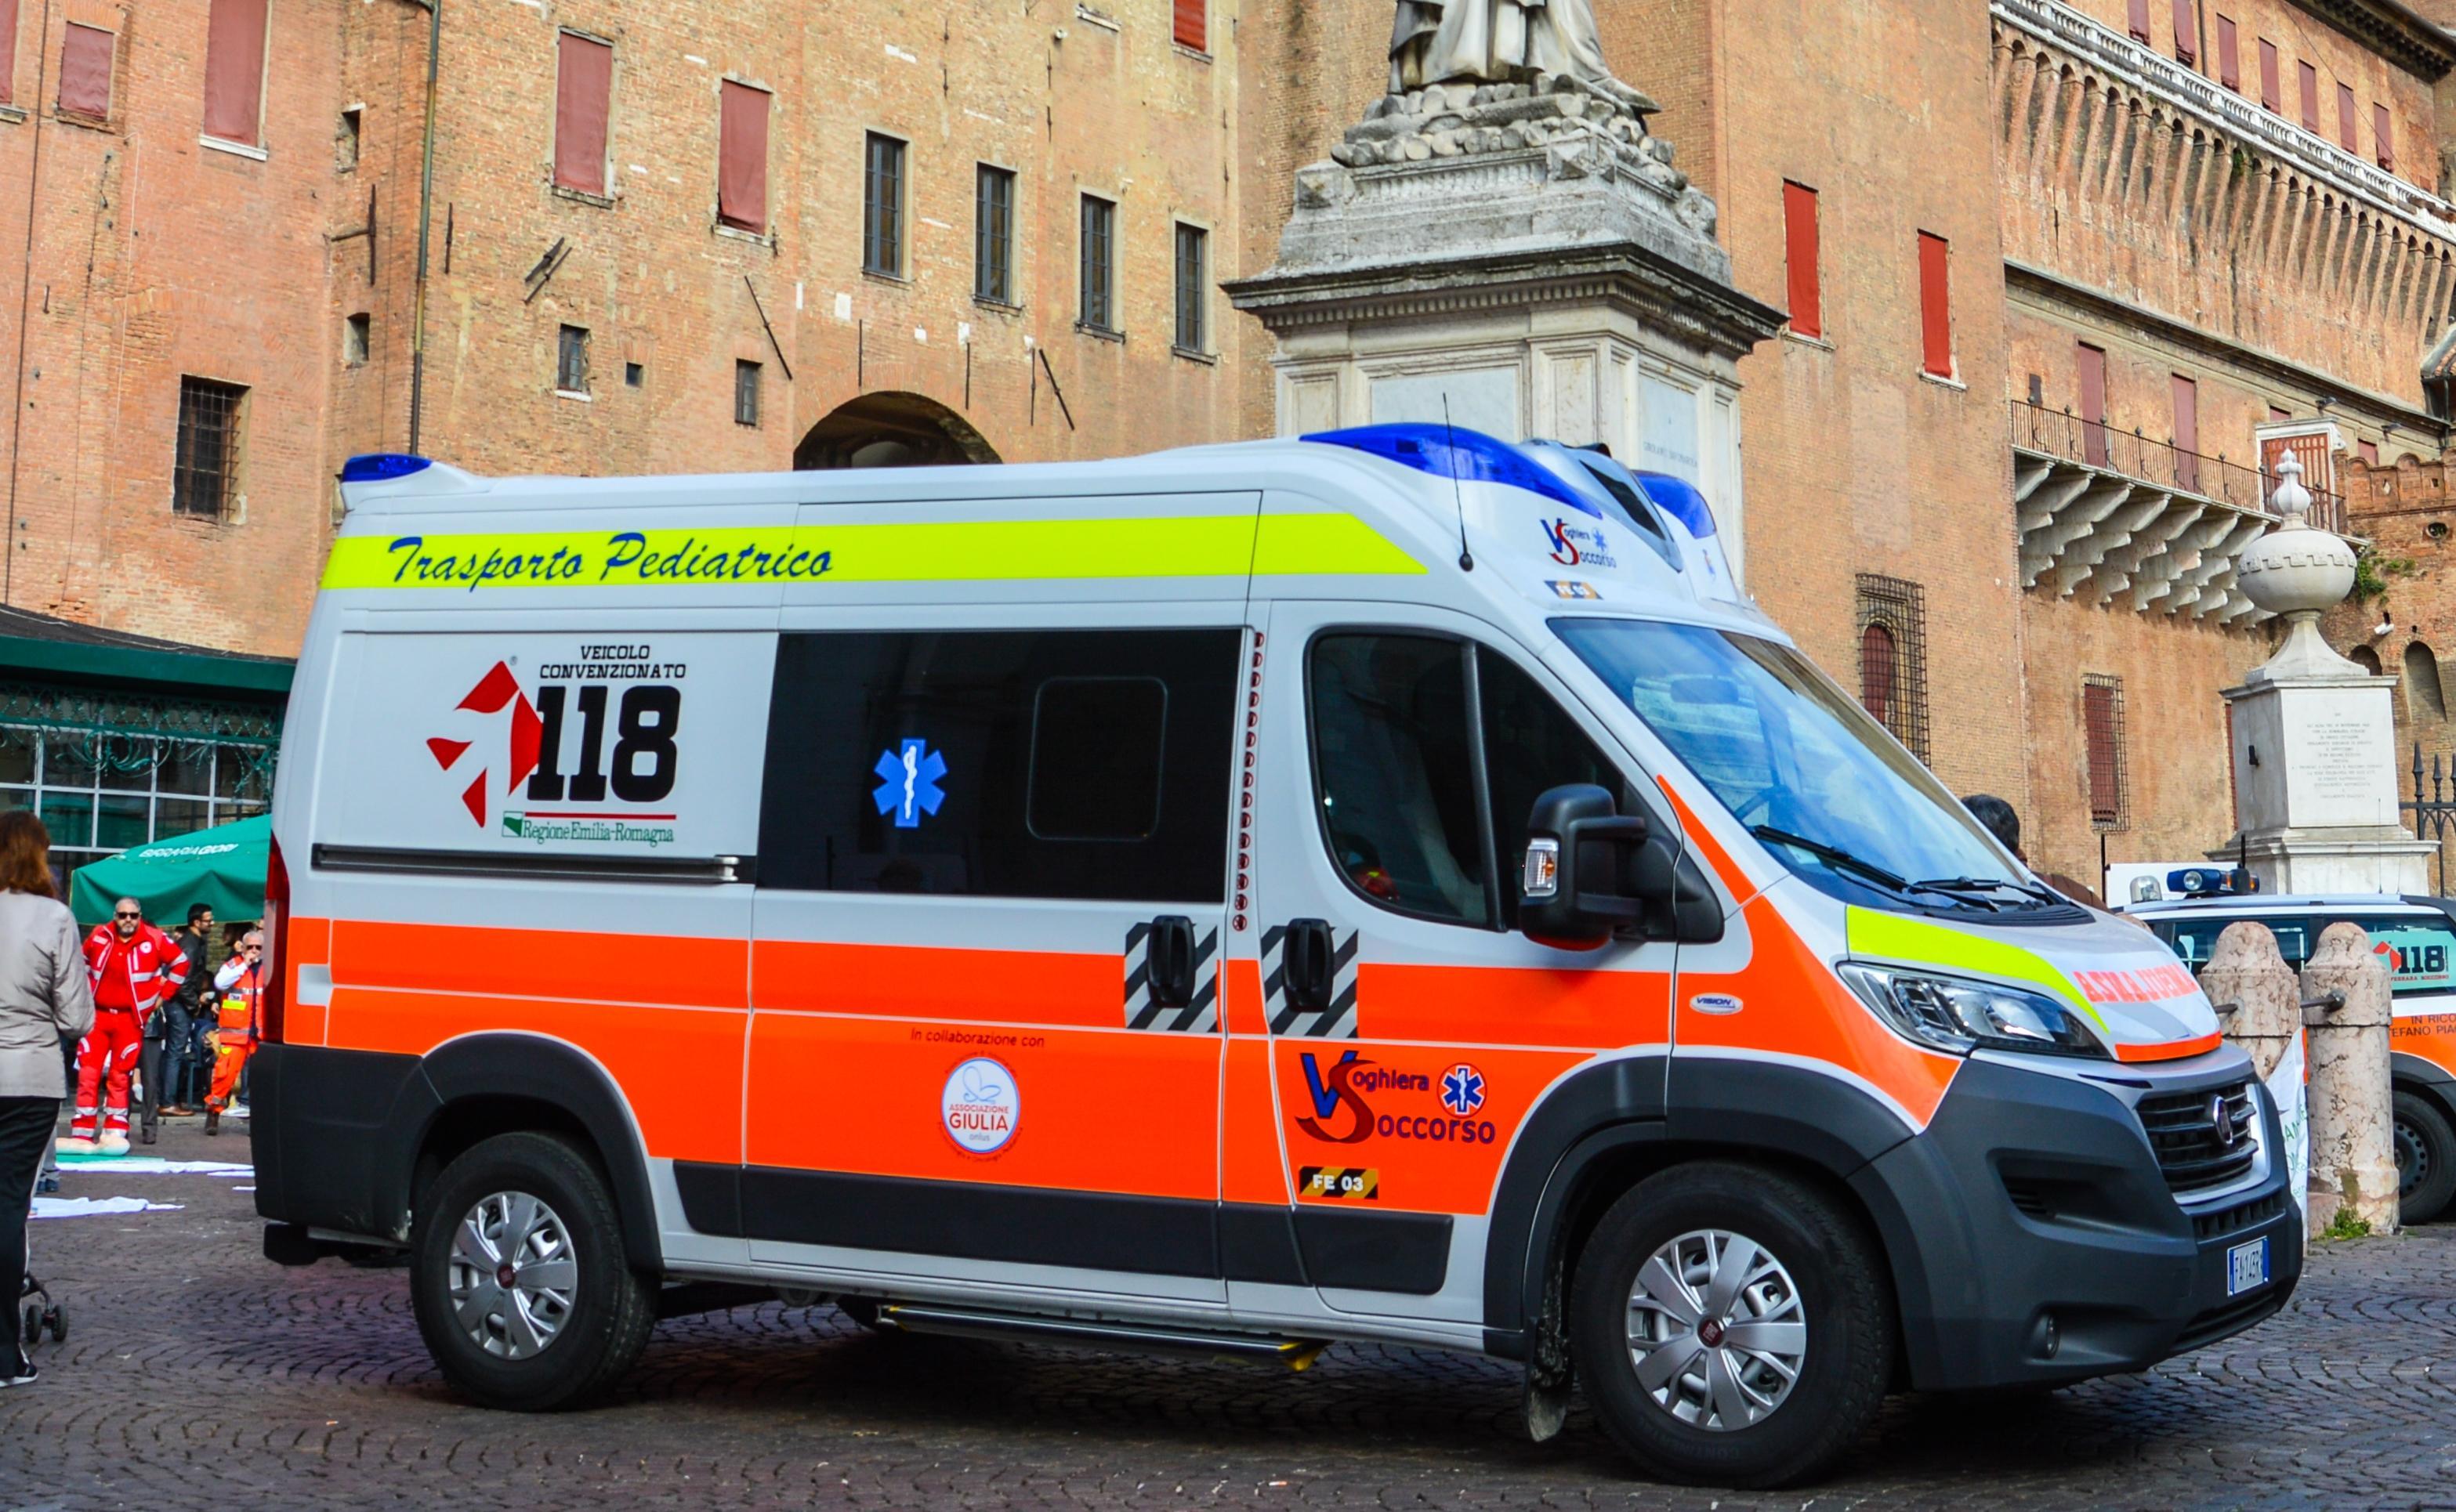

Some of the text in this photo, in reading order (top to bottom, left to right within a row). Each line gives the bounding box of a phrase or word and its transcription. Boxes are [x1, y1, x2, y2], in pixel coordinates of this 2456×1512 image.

[388, 532, 833, 592] Trasporto Pediatrico
[581, 645, 650, 659] VEICOLO
[540, 664, 686, 678] CONVENZIONATO
[527, 685, 681, 802] 118
[523, 820, 674, 848] Regione Emilia-Romagna
[2397, 945, 2445, 974] 118
[2411, 1015, 2422, 1024] IN
[911, 1028, 1045, 1047] In collaborazione con
[2389, 1025, 2431, 1037] EFANO
[949, 1103, 1009, 1114] ASSOCIAZIONE
[1294, 1059, 1496, 1145] Soccorso
[949, 1112, 1009, 1131] GIULIA
[1312, 1174, 1364, 1192] FE 03
